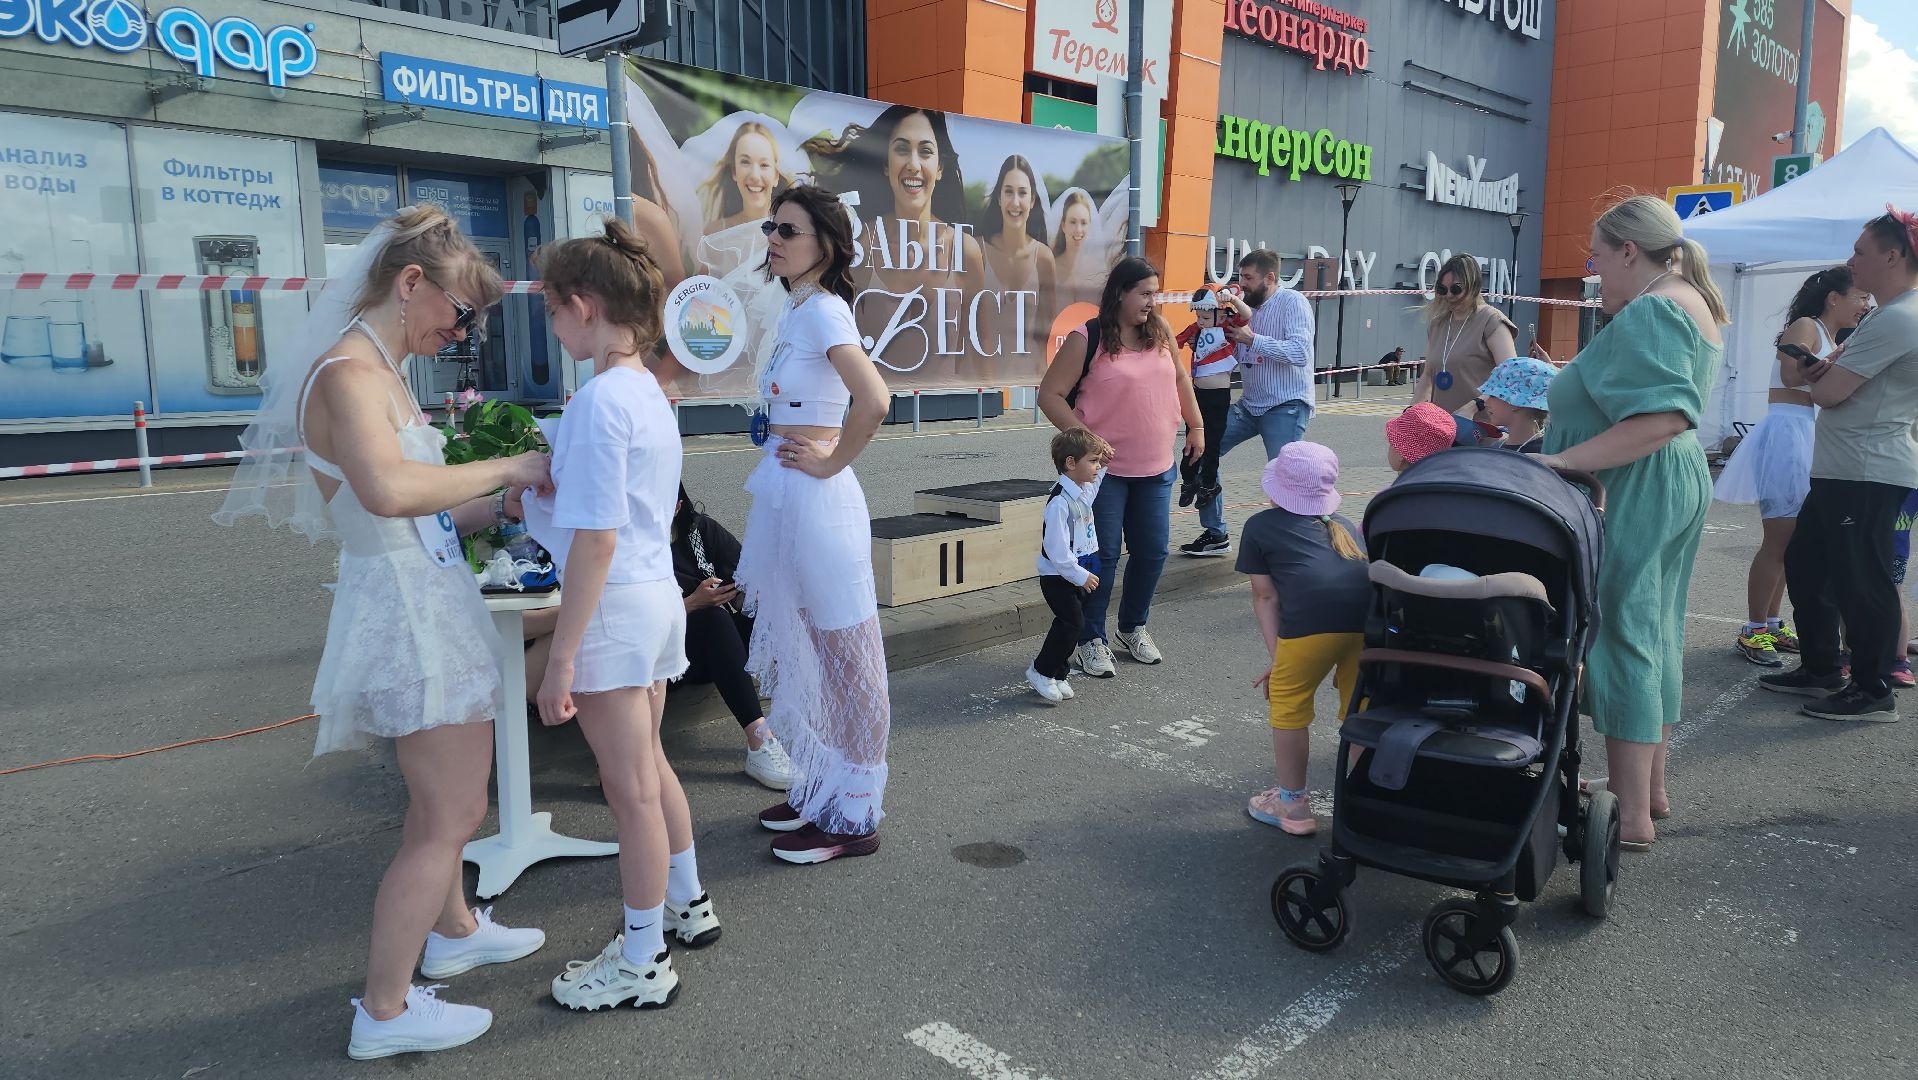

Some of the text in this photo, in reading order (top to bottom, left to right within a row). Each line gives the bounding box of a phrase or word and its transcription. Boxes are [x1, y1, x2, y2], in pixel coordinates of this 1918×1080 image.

[1049, 28, 1157, 85] Теремк
[392, 65, 599, 123] ФИЛЬТРЫ ДЛЯ
[4, 174, 76, 194] воды
[162, 157, 274, 187] Фильтры
[162, 186, 281, 211] в коттедж
[674, 281, 711, 307] SERGIEV
